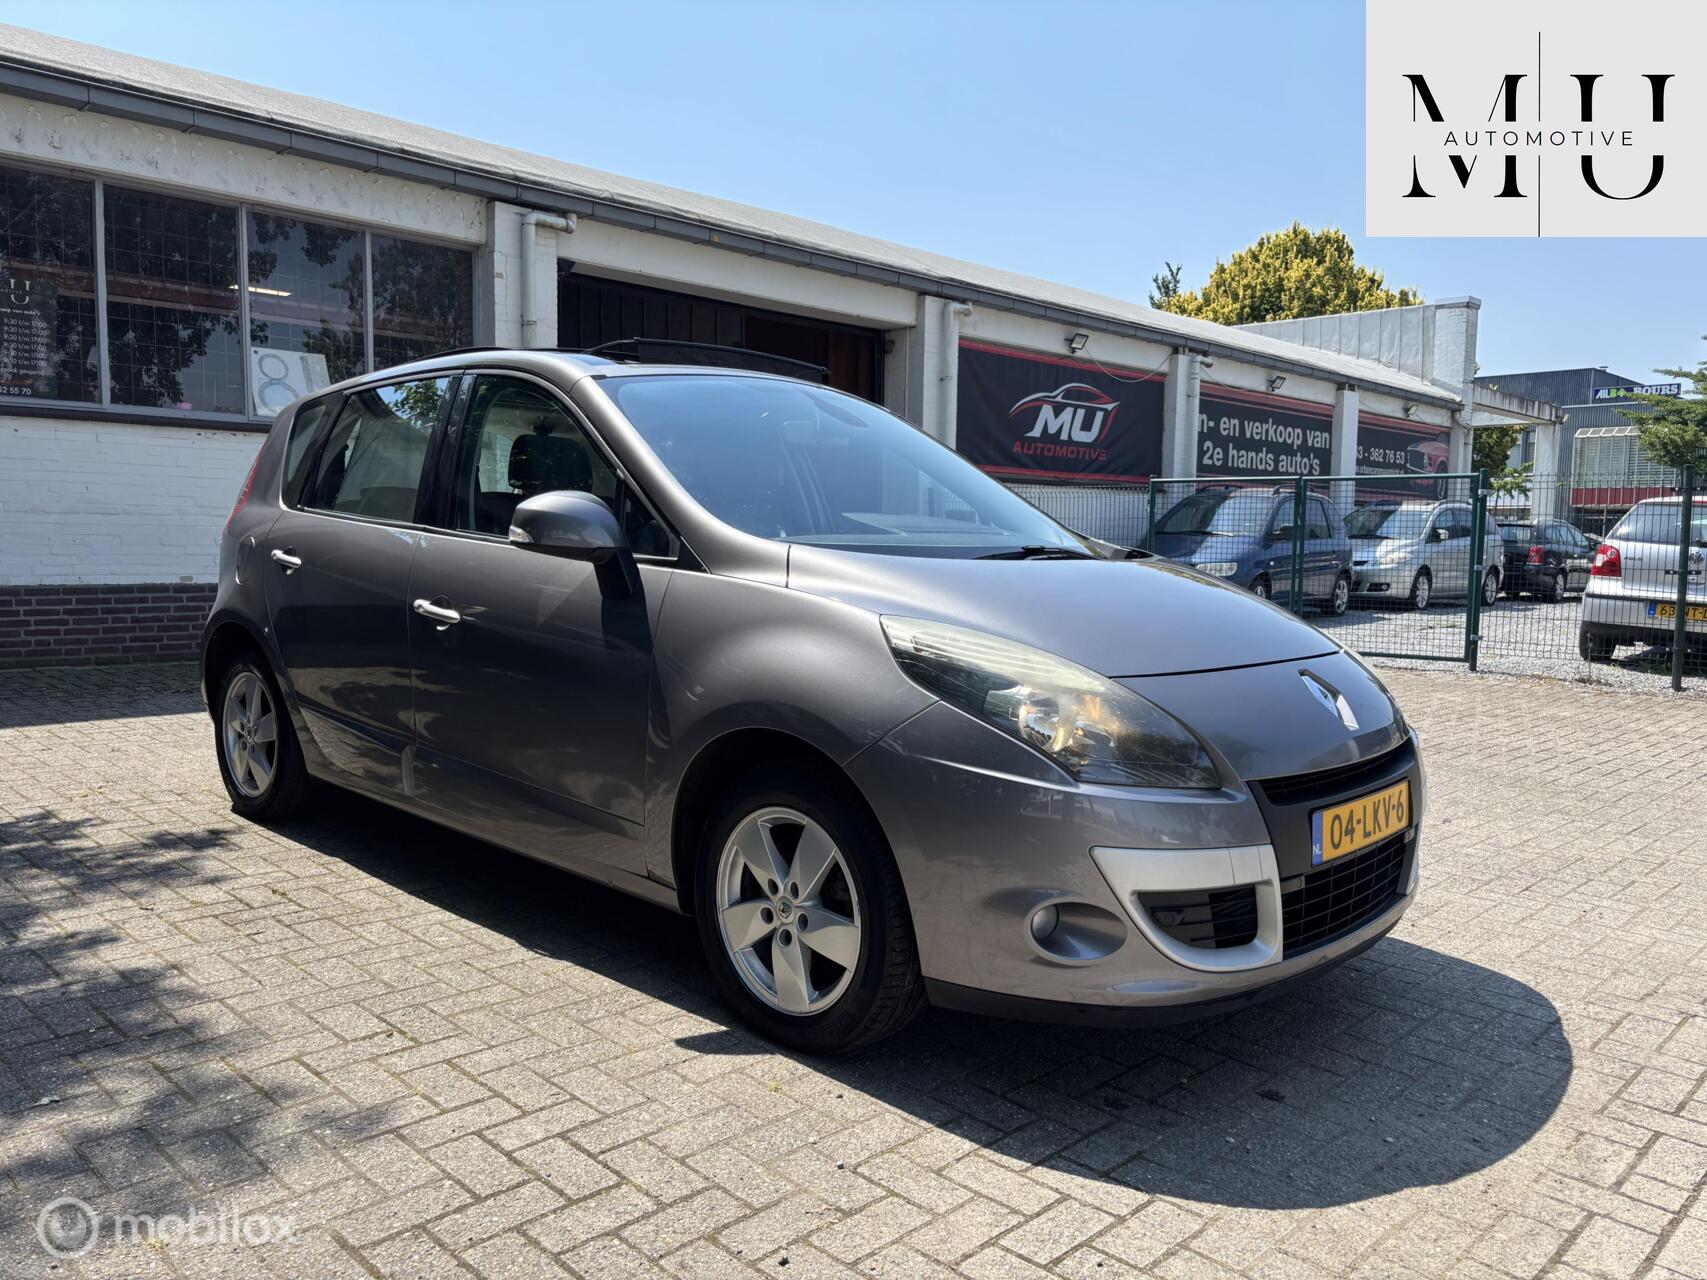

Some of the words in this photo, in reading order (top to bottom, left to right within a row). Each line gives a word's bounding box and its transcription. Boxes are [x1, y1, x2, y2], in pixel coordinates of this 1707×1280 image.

[9, 387, 20, 395] 55
[21, 387, 32, 396] 70
[1024, 404, 1104, 443] MU
[1220, 416, 1239, 437] en
[1244, 418, 1302, 450] verkoop
[1306, 429, 1330, 449] van
[1013, 441, 1107, 461] AUTOMOTIVE
[1202, 440, 1223, 466] 2e
[1228, 443, 1274, 471] hands
[1279, 452, 1320, 476] auto's
[1370, 447, 1384, 462] 362
[1385, 449, 1395, 463] 76
[1395, 451, 1405, 464] 53
[1330, 789, 1404, 850] 04-LKV-6
[1312, 844, 1322, 854] NL
